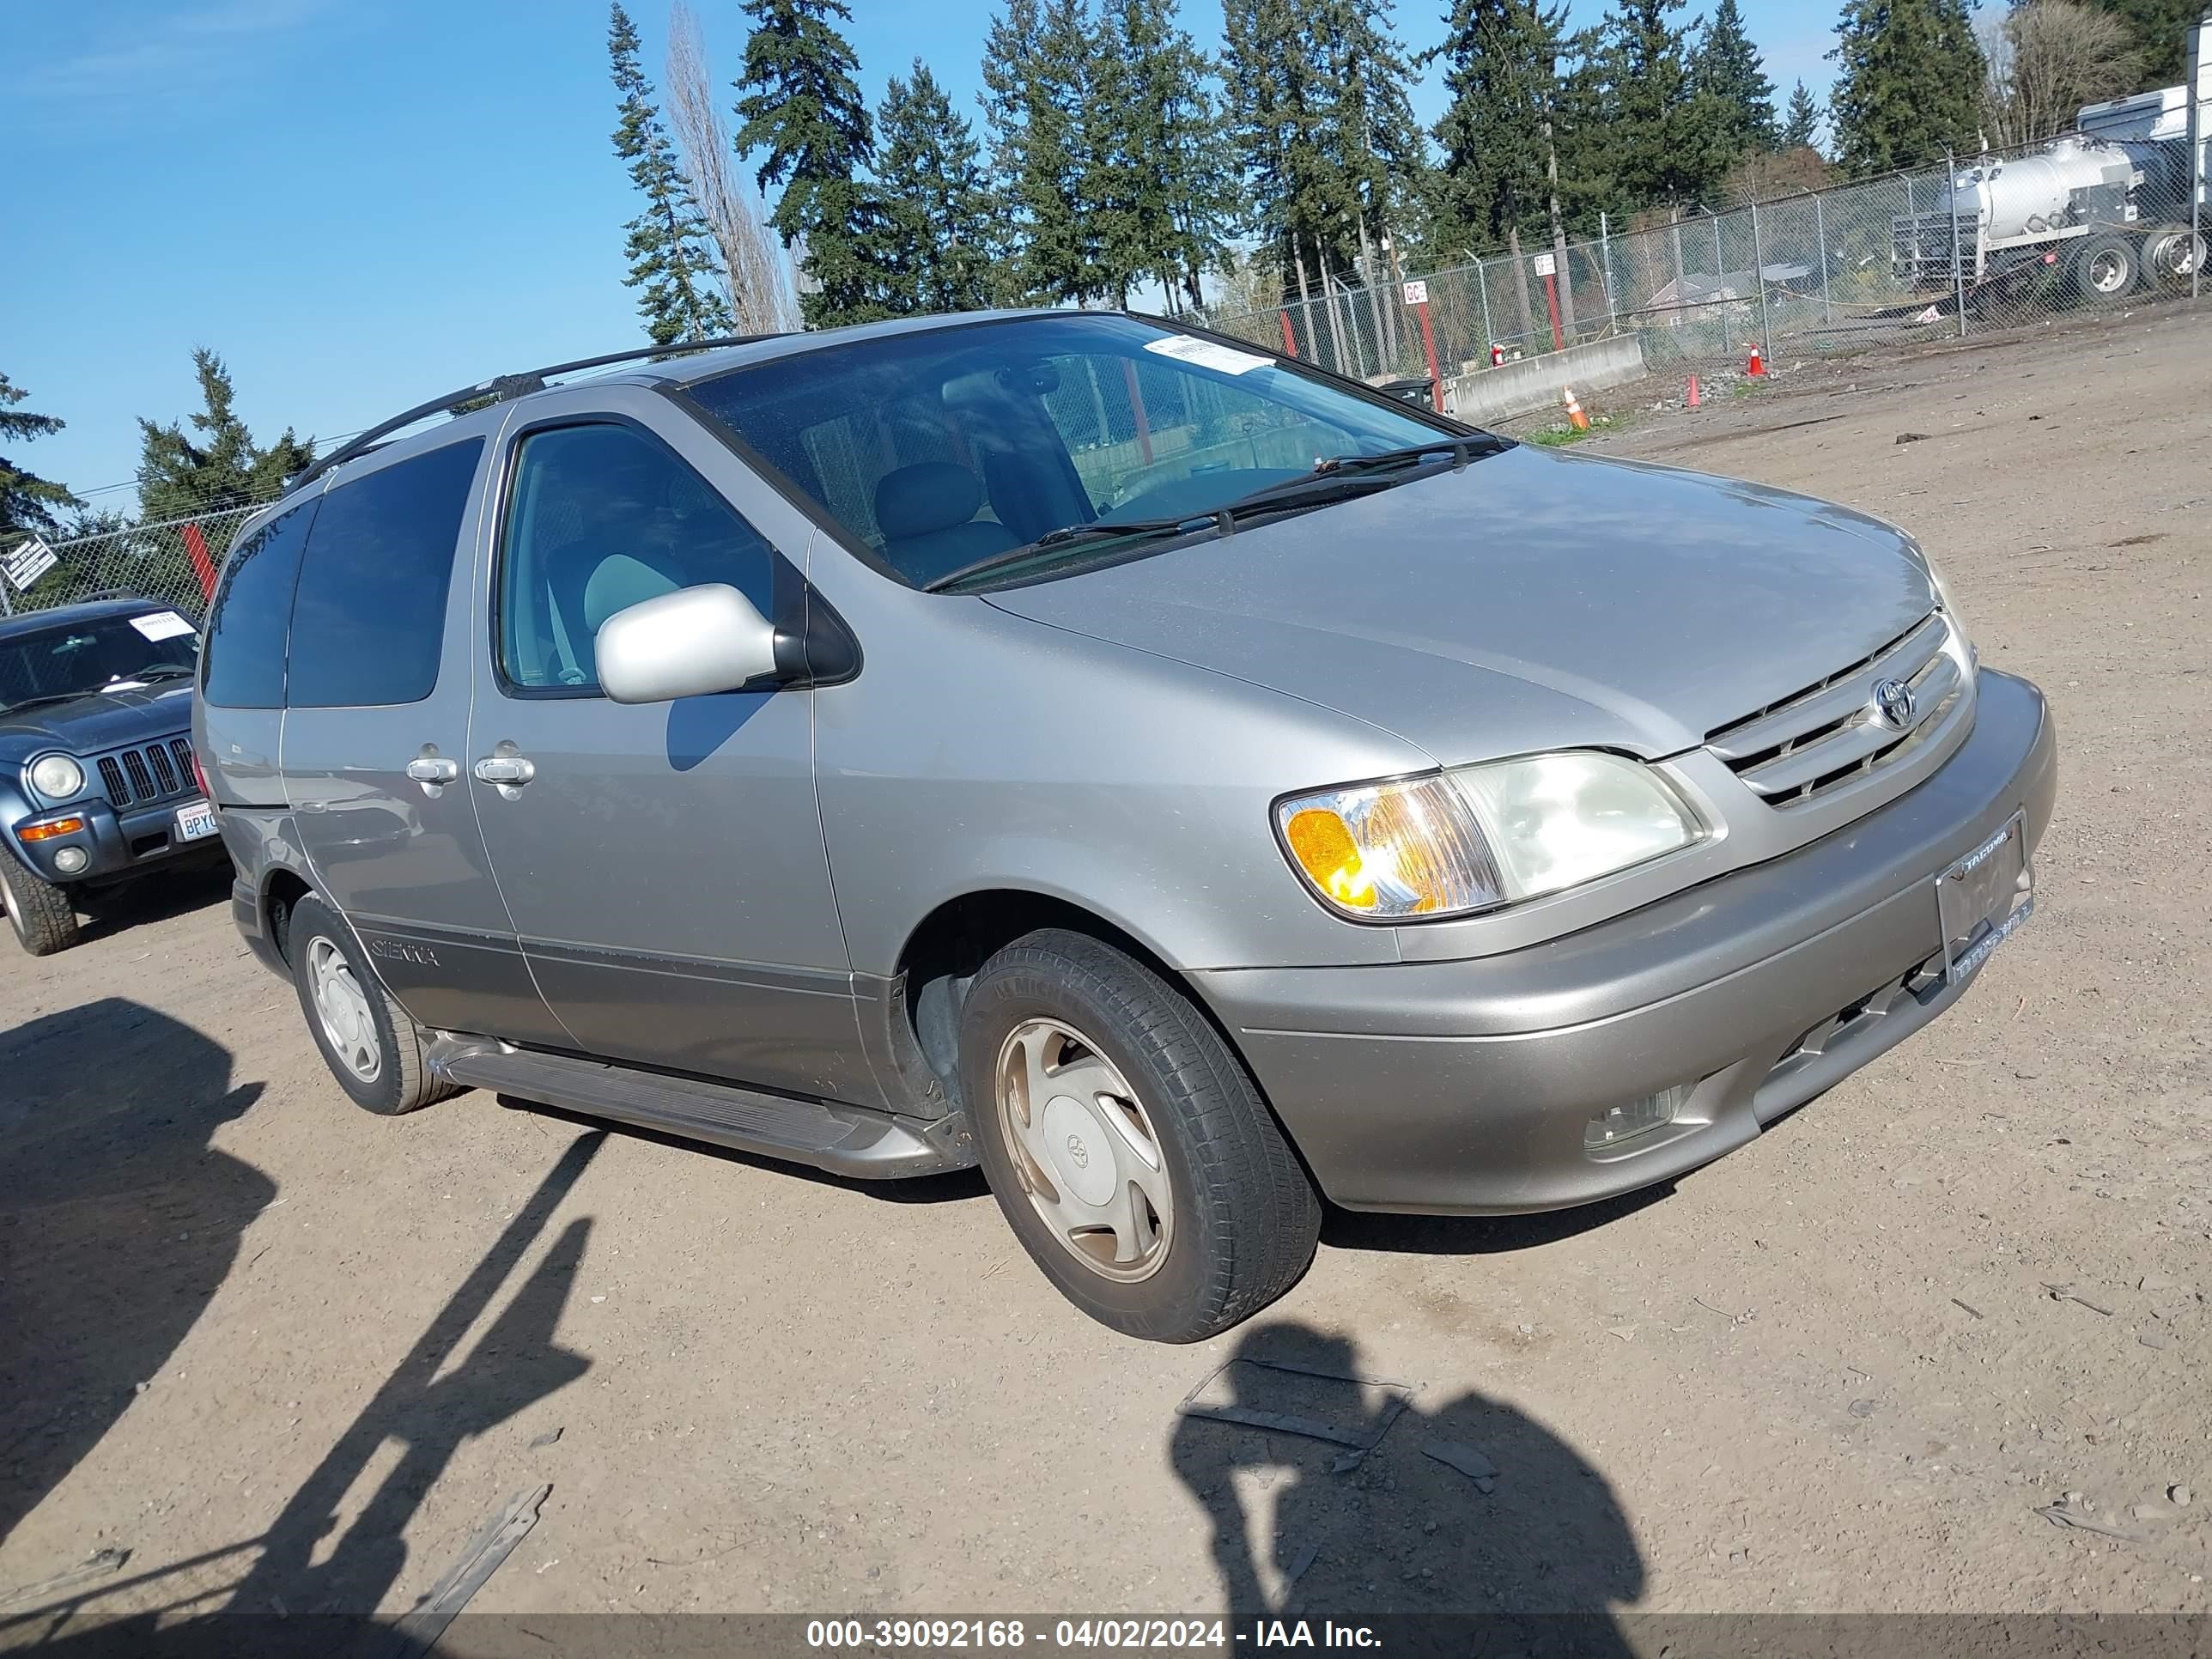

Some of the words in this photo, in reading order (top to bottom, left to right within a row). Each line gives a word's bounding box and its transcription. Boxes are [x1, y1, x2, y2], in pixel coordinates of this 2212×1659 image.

[1407, 284, 1419, 301] GC
[1966, 830, 2008, 872] TACOMA
[371, 940, 441, 967] SIENNA
